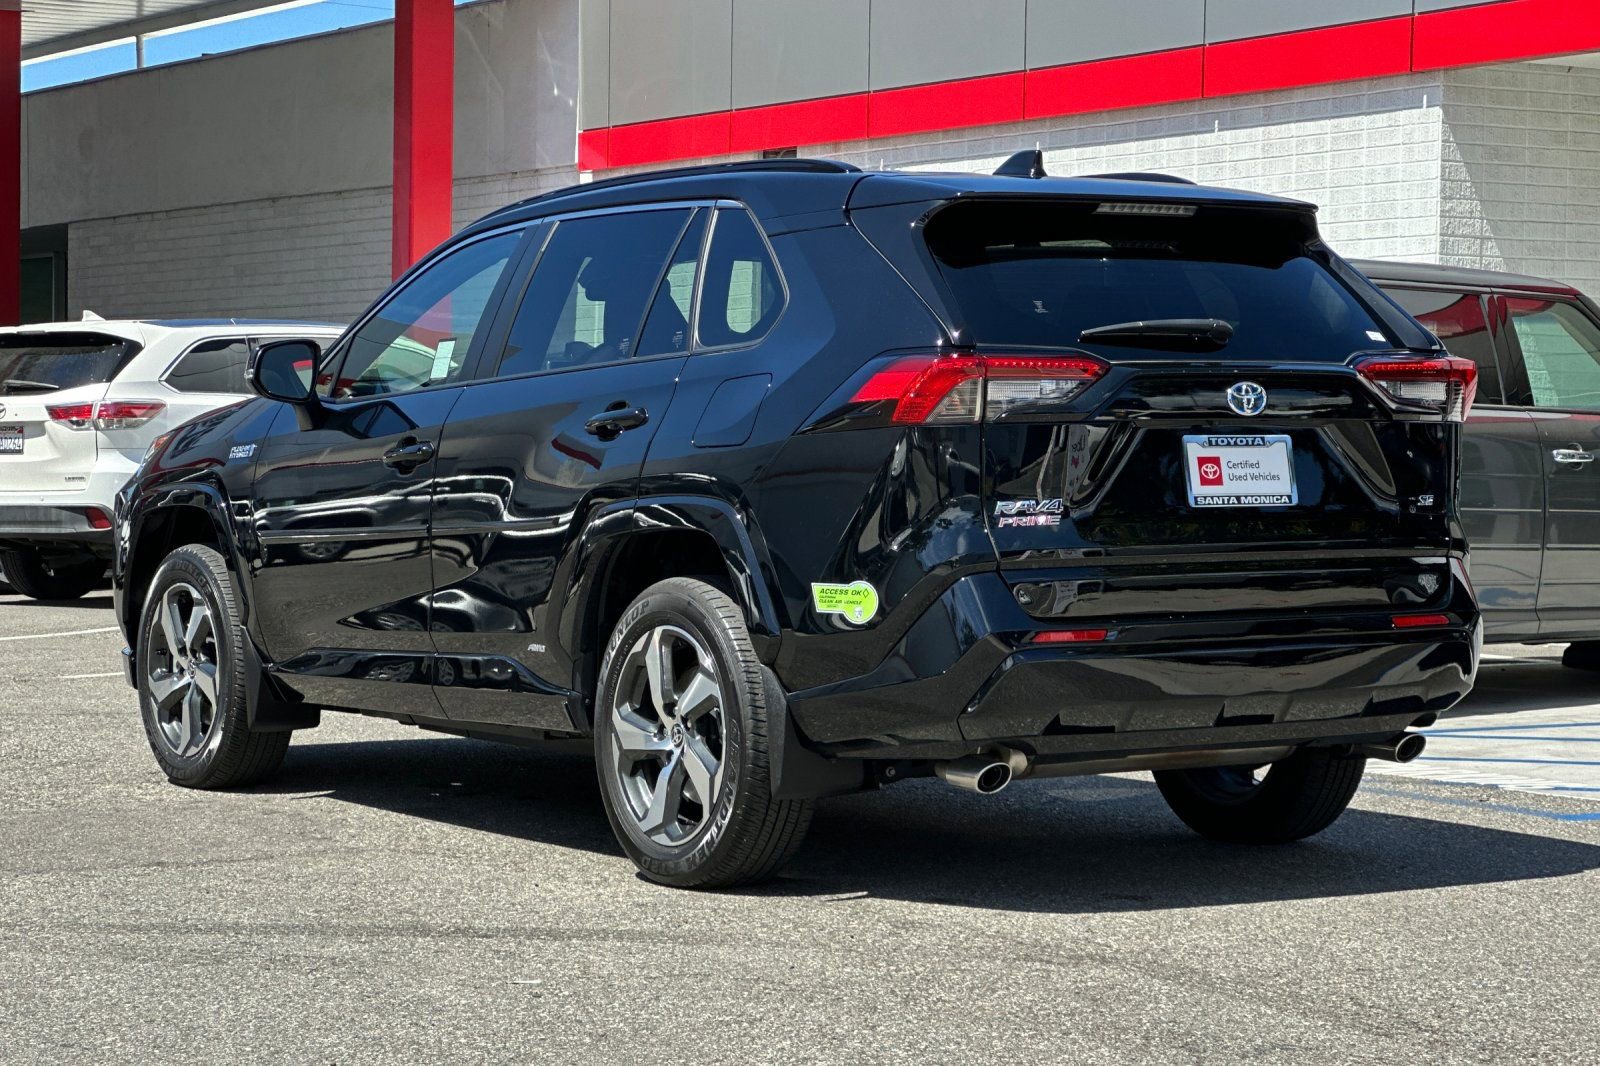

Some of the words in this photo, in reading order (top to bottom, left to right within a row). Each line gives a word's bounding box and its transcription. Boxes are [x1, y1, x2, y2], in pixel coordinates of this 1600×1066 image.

[1209, 438, 1264, 446] TOYOTA
[1227, 461, 1260, 469] Certified
[1229, 473, 1248, 481] Used
[1249, 472, 1281, 481] Vehicles
[1197, 496, 1239, 505] SANTA
[1241, 495, 1290, 504] MONICA
[995, 498, 1064, 514] RAV4
[820, 588, 849, 596] ACCESS
